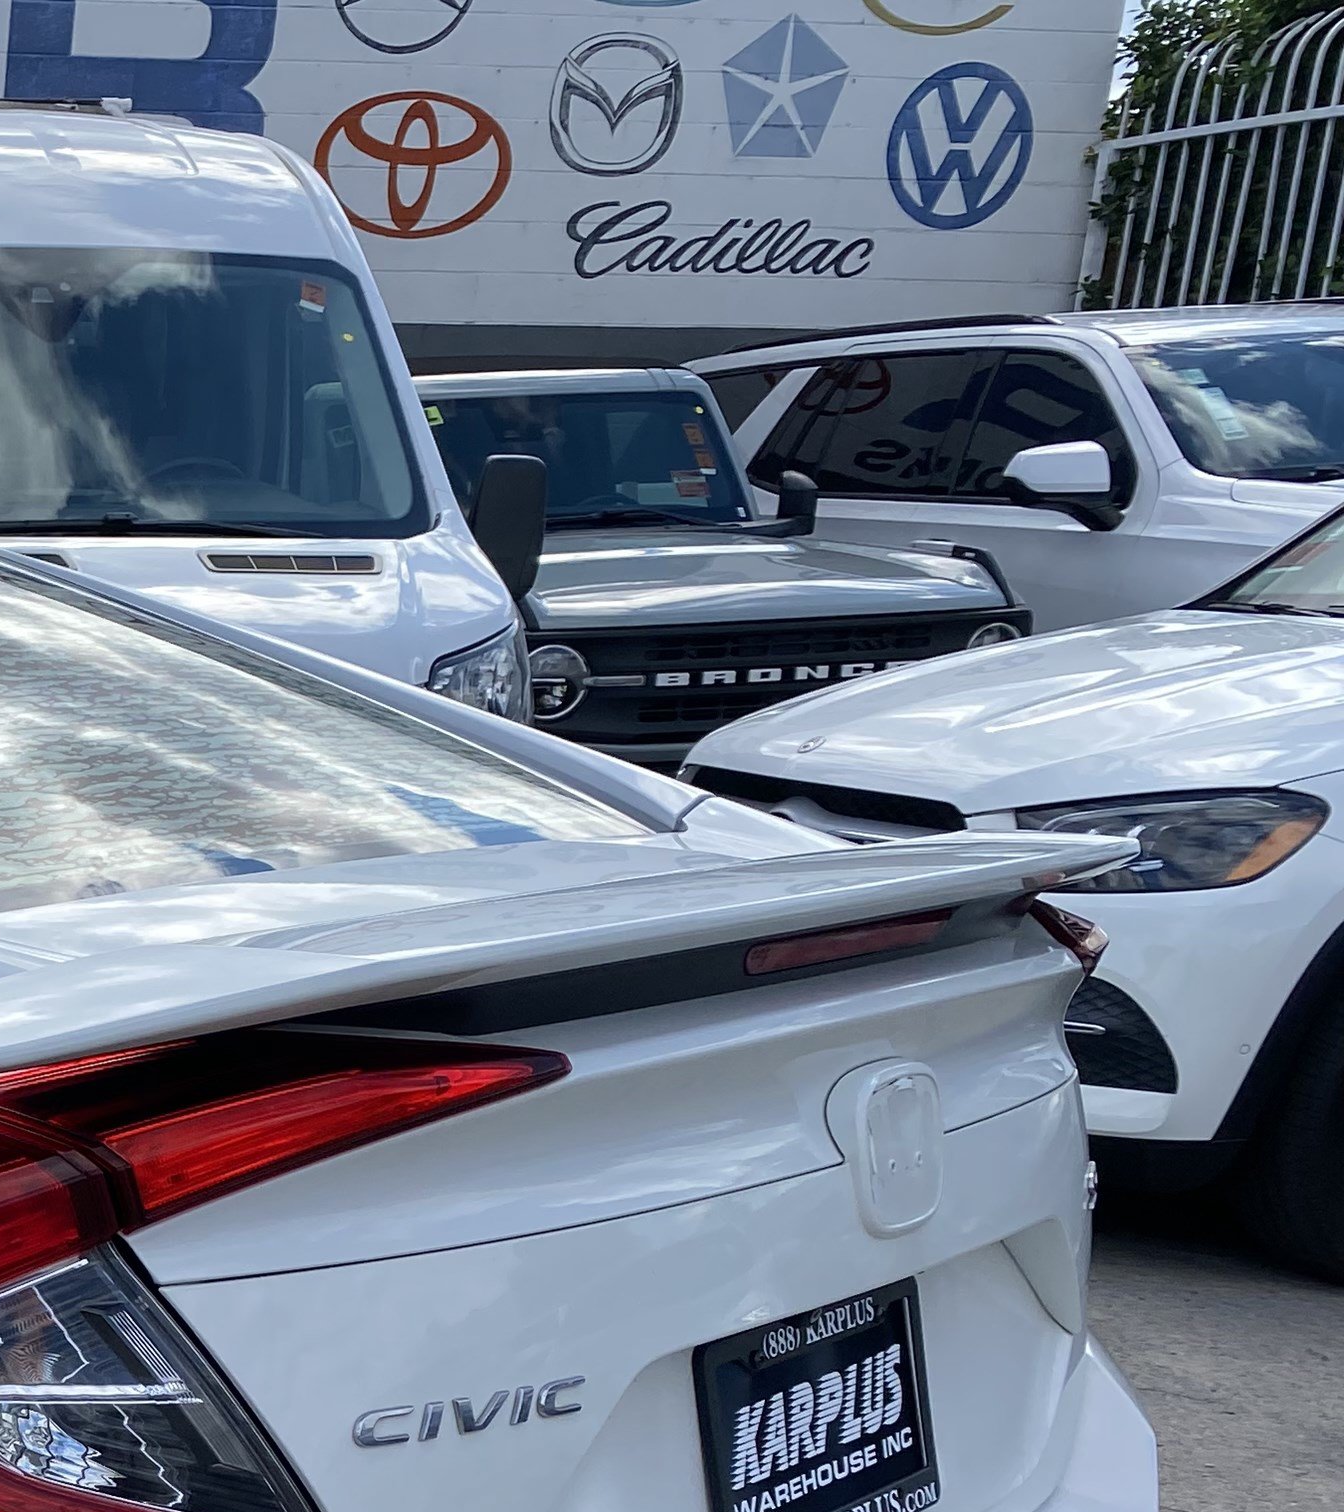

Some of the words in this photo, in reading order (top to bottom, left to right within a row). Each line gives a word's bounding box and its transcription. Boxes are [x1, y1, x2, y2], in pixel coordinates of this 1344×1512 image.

[566, 200, 875, 279] Cadillac
[763, 1325, 801, 1359] (888)
[805, 1297, 875, 1345] KARPLUS
[352, 1374, 587, 1449] CIVIC
[731, 1343, 903, 1491] KARPLUS
[883, 1427, 913, 1459] INC
